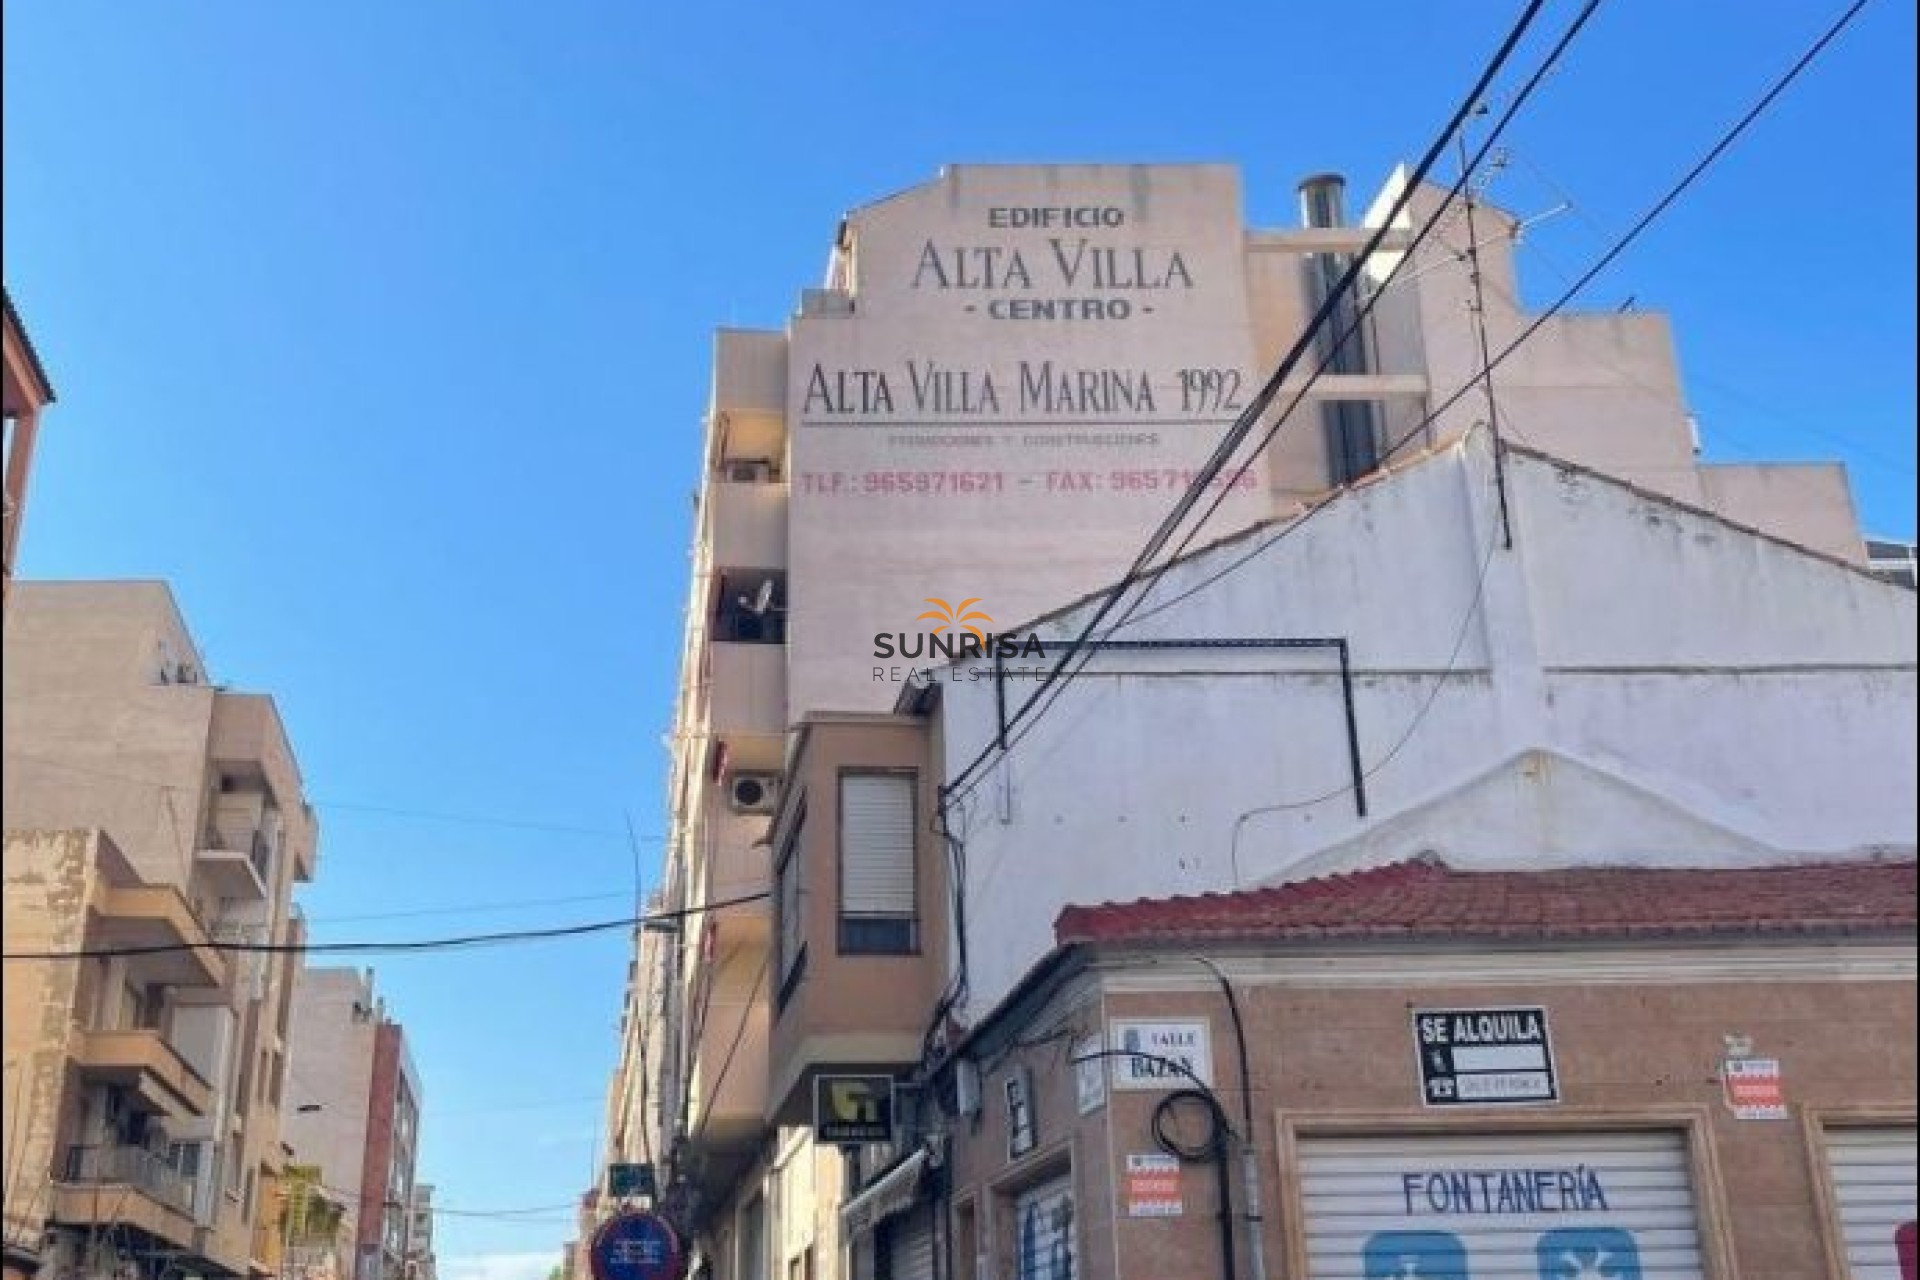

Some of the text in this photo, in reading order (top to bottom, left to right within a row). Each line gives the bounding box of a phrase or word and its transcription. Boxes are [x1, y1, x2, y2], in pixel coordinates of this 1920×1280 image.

[988, 207, 1125, 229] EDIFICIO
[911, 237, 1194, 290] ALTA VILLA
[988, 299, 1131, 320] CENTRO
[803, 359, 1241, 414] ALTA VILLA MARINA 1992
[1422, 1012, 1541, 1044] SE ALQUILA
[1402, 1163, 1609, 1216] FONTANERÍA
